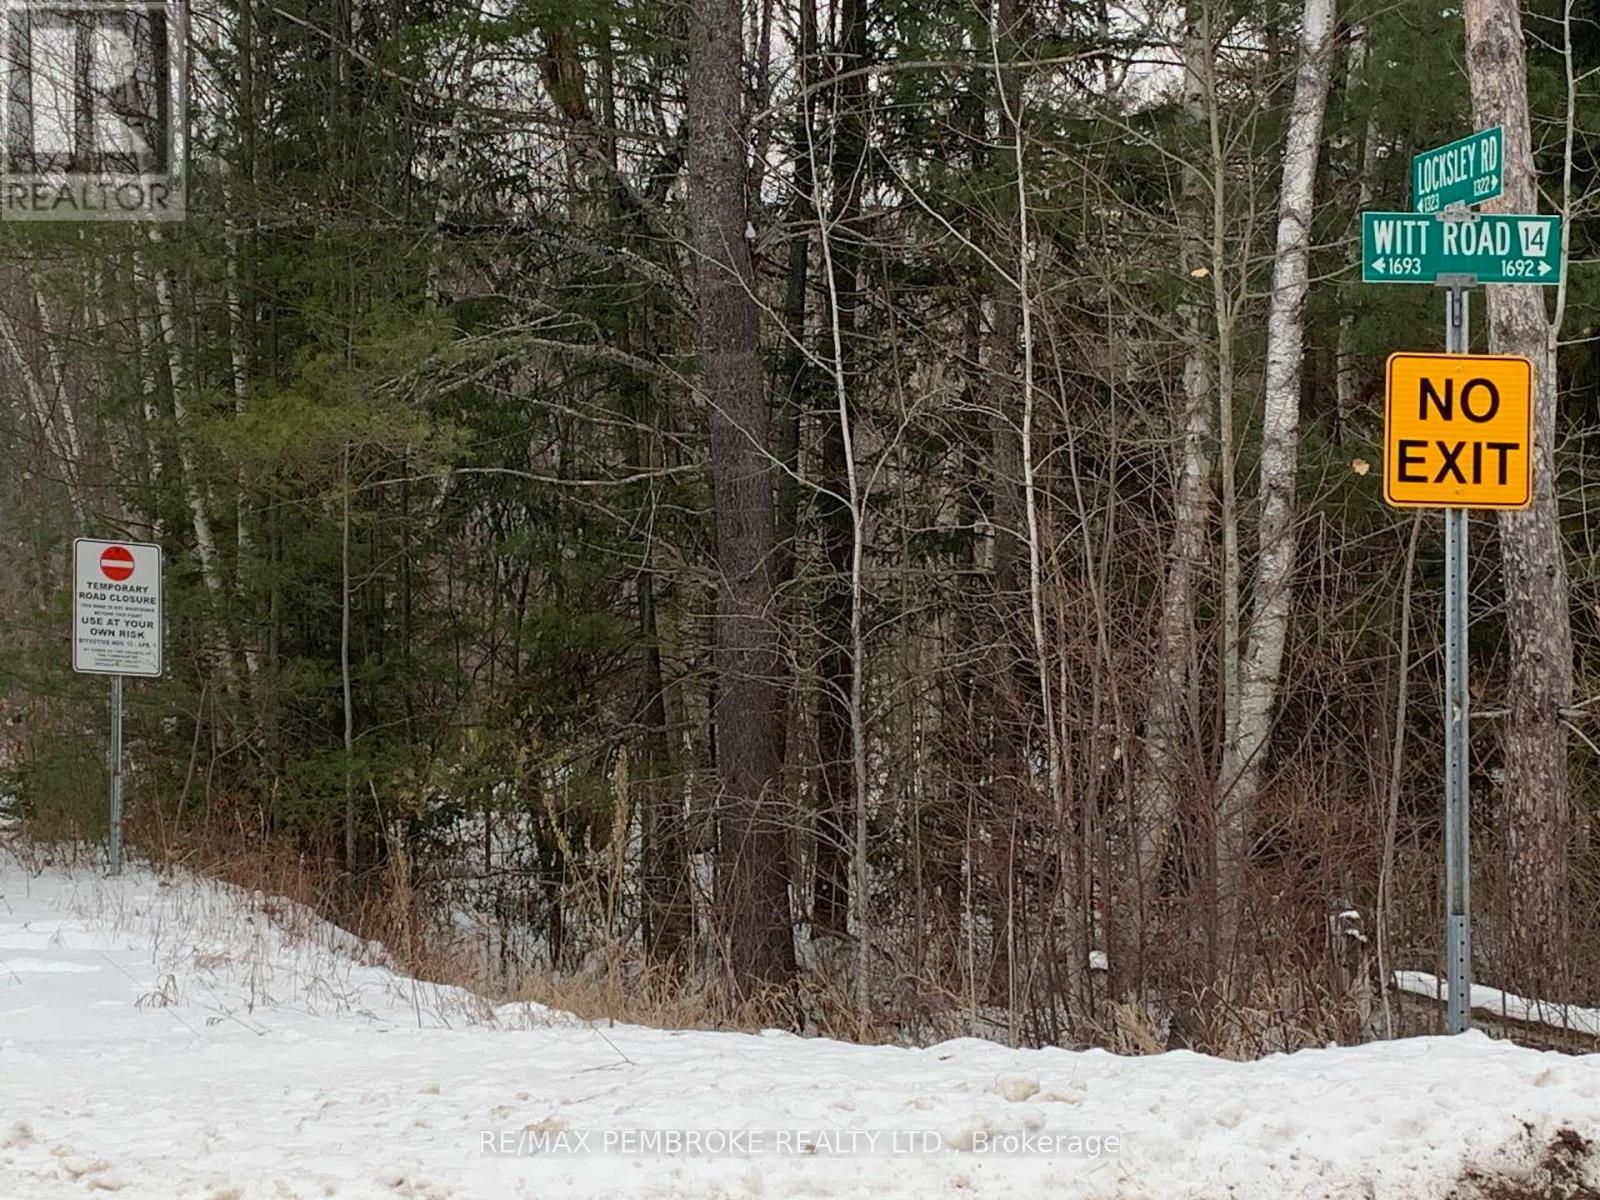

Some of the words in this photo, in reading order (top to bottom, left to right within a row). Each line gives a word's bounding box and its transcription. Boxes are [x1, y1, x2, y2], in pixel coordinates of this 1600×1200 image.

[1418, 142, 1476, 195] LOCKSLEY
[1481, 136, 1497, 174] RD
[1473, 176, 1490, 197] 1322
[1424, 193, 1440, 213] 1323
[1373, 220, 1430, 255] WITT
[1443, 221, 1511, 256] ROAD
[1524, 226, 1545, 252] 14
[1388, 257, 1422, 275] 1693
[1501, 259, 1535, 277] 1692
[1419, 377, 1500, 424] NO
[1398, 439, 1520, 485] EXIT
[87, 582, 148, 593] TEMPORARY
[79, 591, 107, 601] ROAD
[109, 594, 156, 605] CLOSURE
[81, 617, 103, 626] USE
[125, 620, 154, 629] YOUR
[90, 628, 115, 637] OWN
[120, 630, 145, 639] RISK
